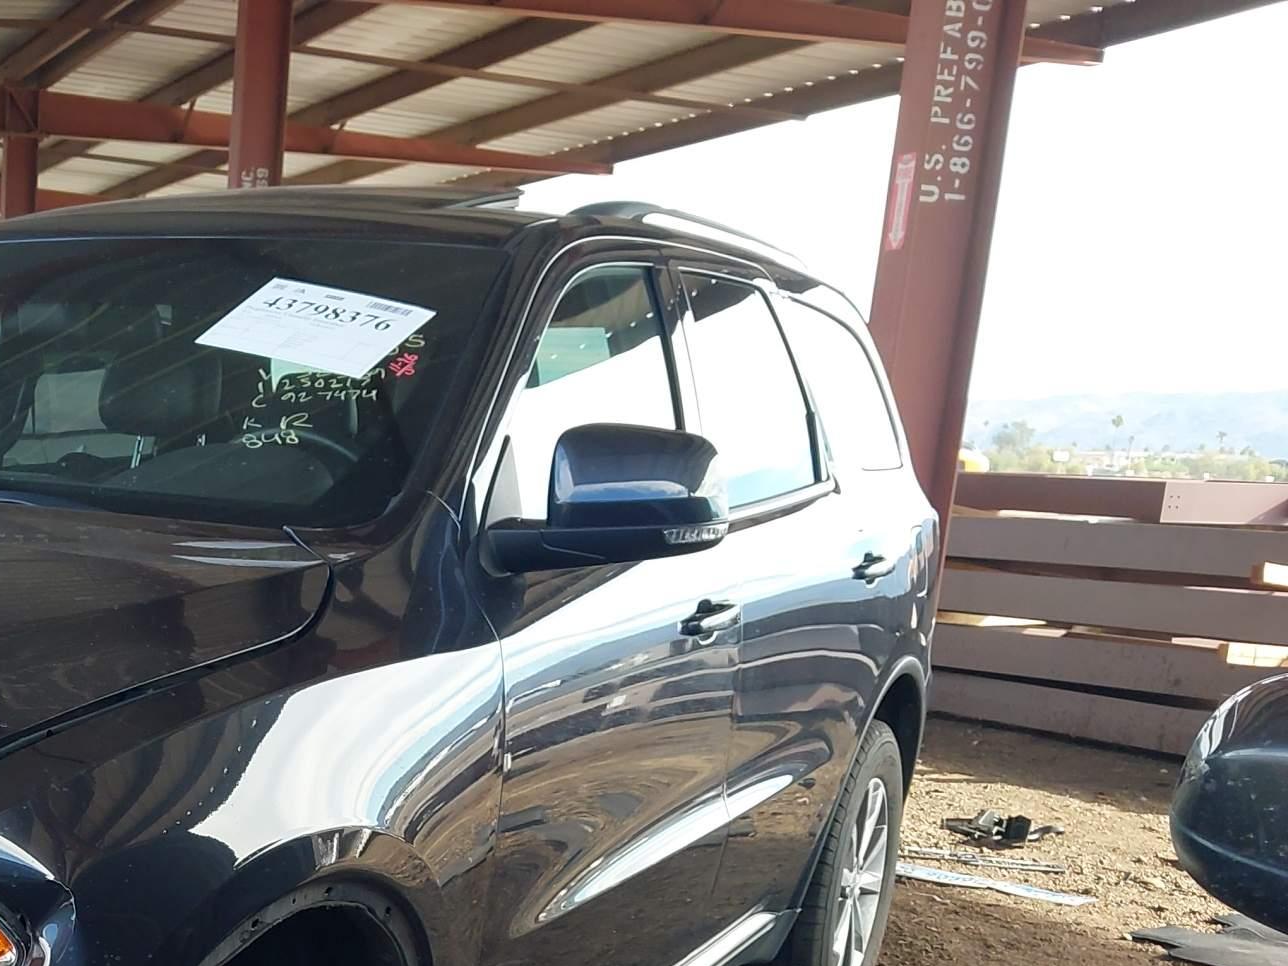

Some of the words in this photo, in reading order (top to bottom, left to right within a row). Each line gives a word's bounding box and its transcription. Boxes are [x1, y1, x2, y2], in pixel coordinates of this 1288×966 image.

[930, 0, 966, 124] PREFAB
[919, 145, 946, 203] U.S.
[263, 296, 395, 331] 43798376
